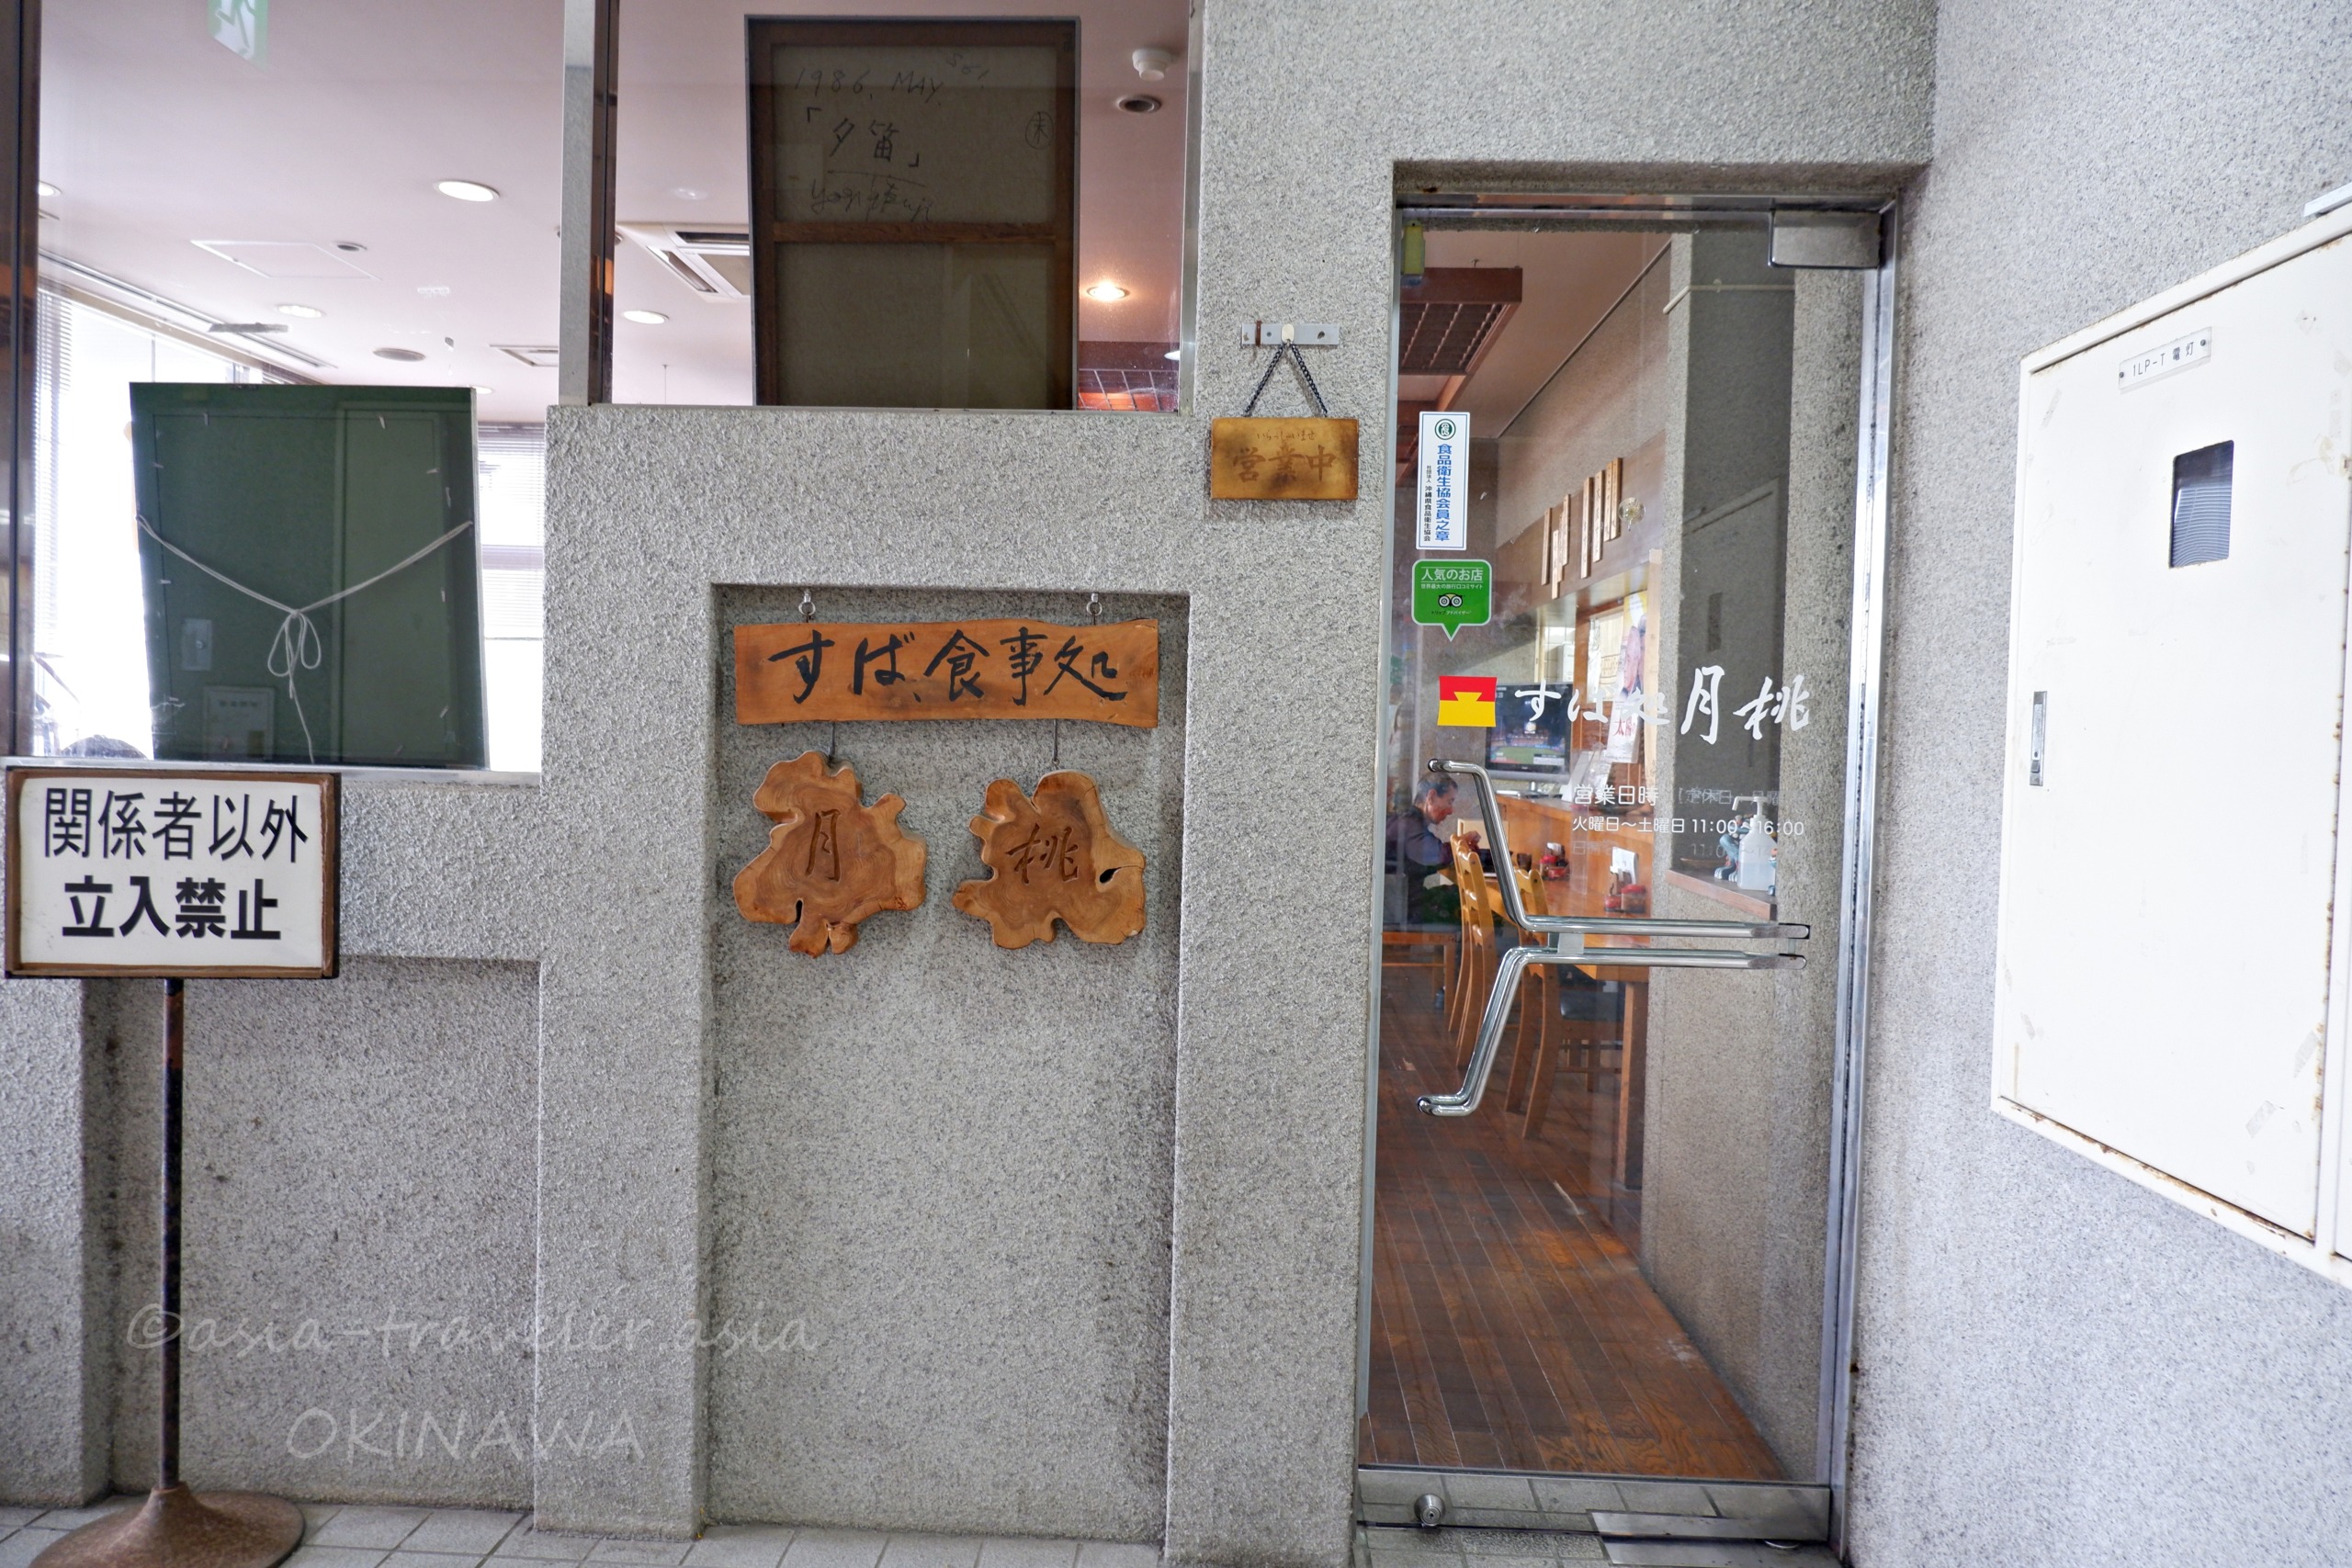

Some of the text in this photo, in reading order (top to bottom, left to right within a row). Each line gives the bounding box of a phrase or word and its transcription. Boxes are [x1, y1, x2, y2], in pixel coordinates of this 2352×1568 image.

[2132, 352, 2165, 378] 1LP-T
[1232, 444, 1337, 484] 営業中
[1435, 443, 1453, 542] 食品衛生協会員之章
[1421, 568, 1484, 581] 人気のお店
[1574, 784, 1659, 806] 営業日時
[44, 787, 309, 863] 関係者以外
[62, 874, 281, 941] 立入禁止
